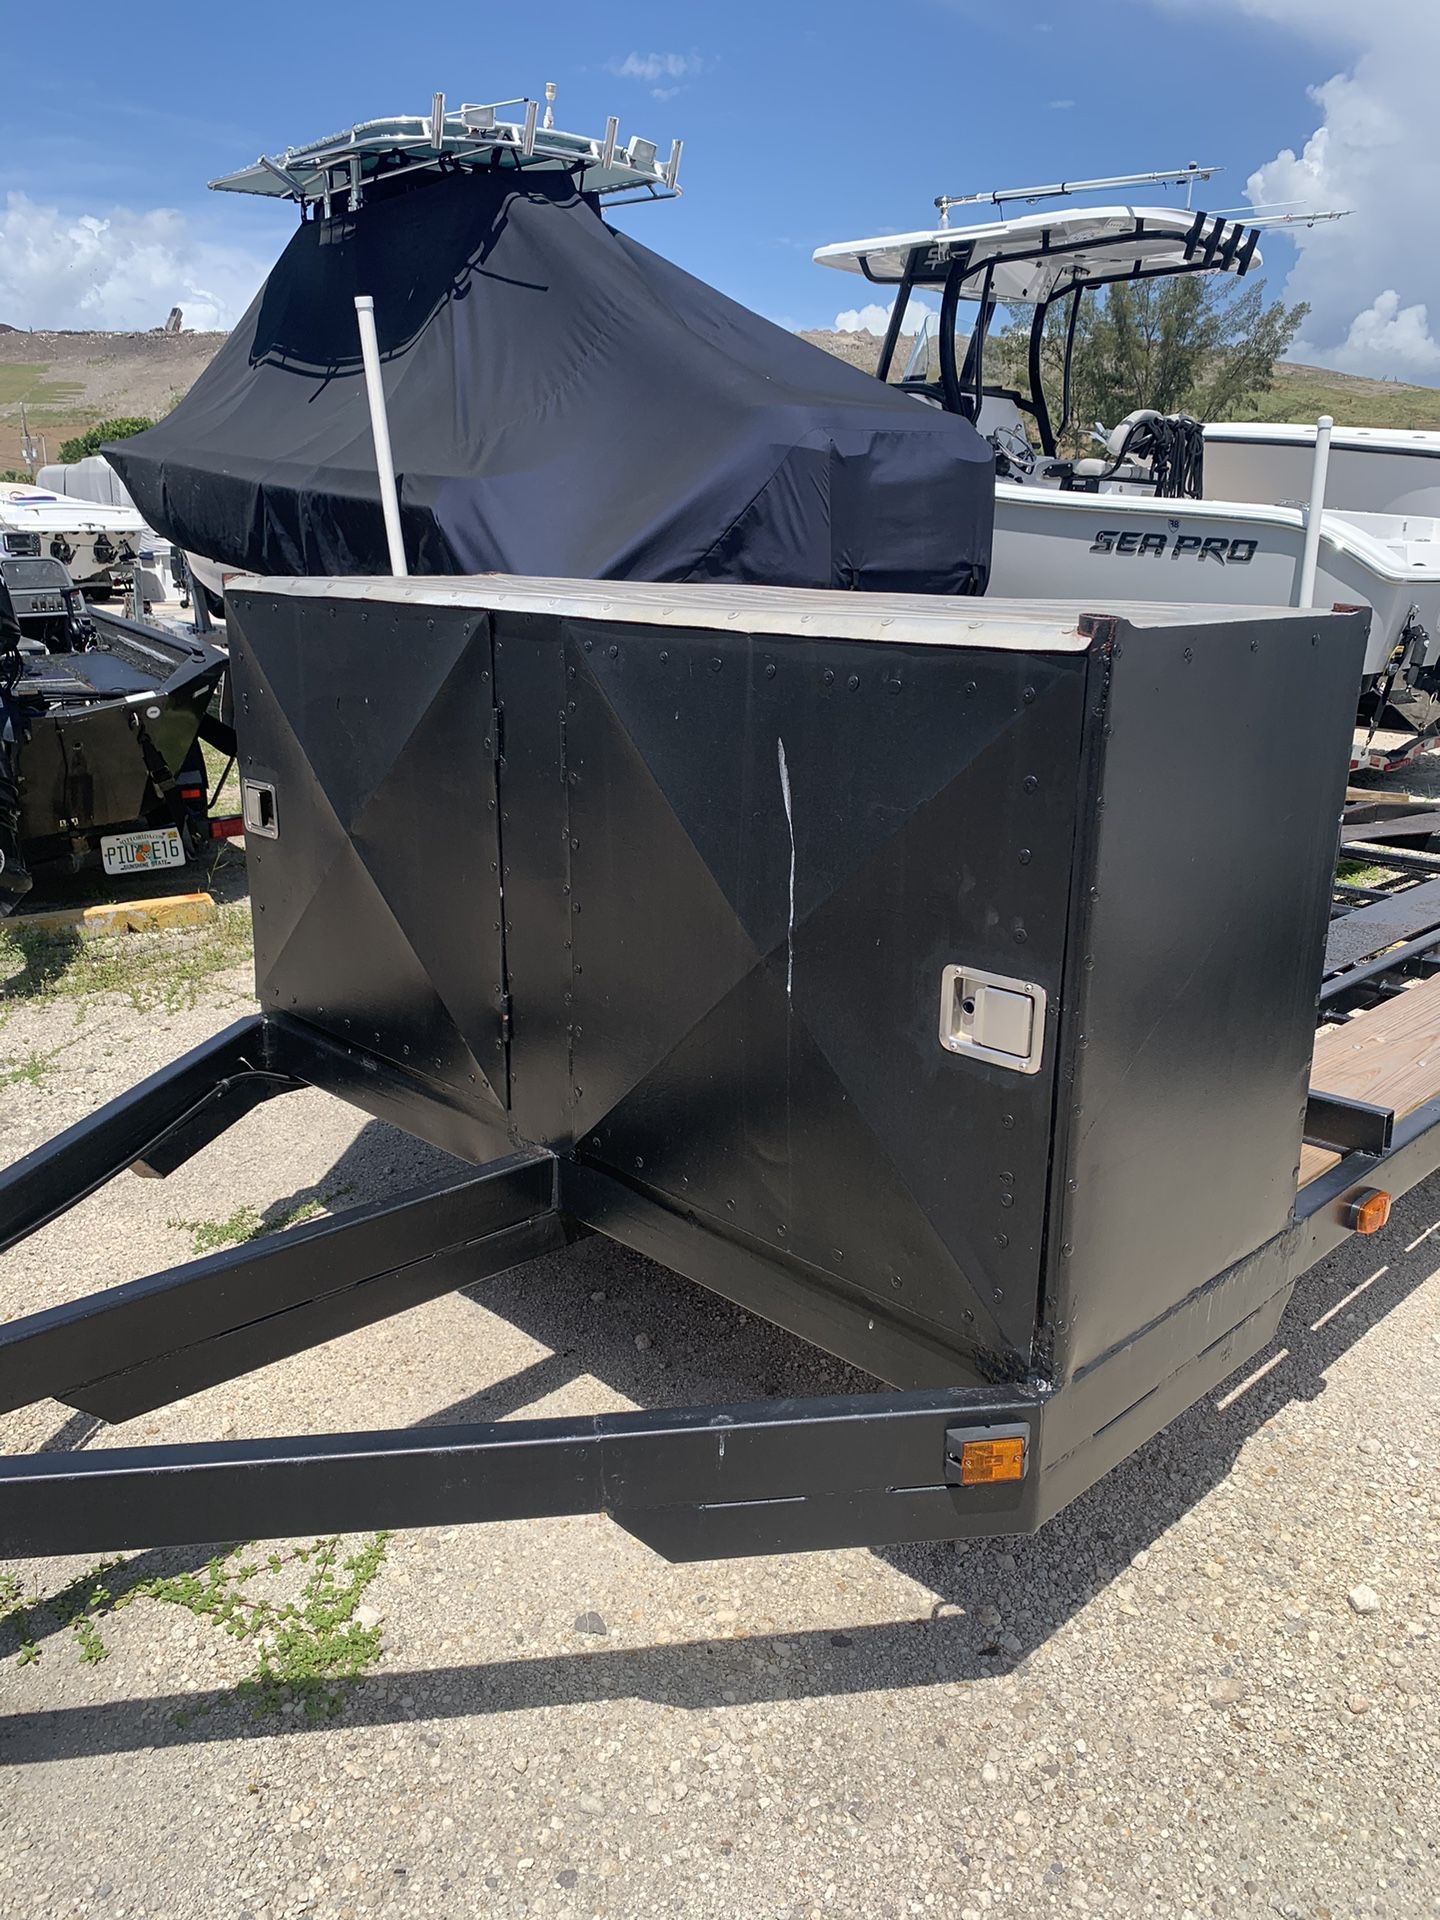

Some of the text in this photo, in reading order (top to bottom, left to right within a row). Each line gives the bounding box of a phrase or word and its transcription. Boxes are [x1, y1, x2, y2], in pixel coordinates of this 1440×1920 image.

[1089, 531, 1259, 567] SEA PRO
[107, 839, 179, 866] PIU E16
